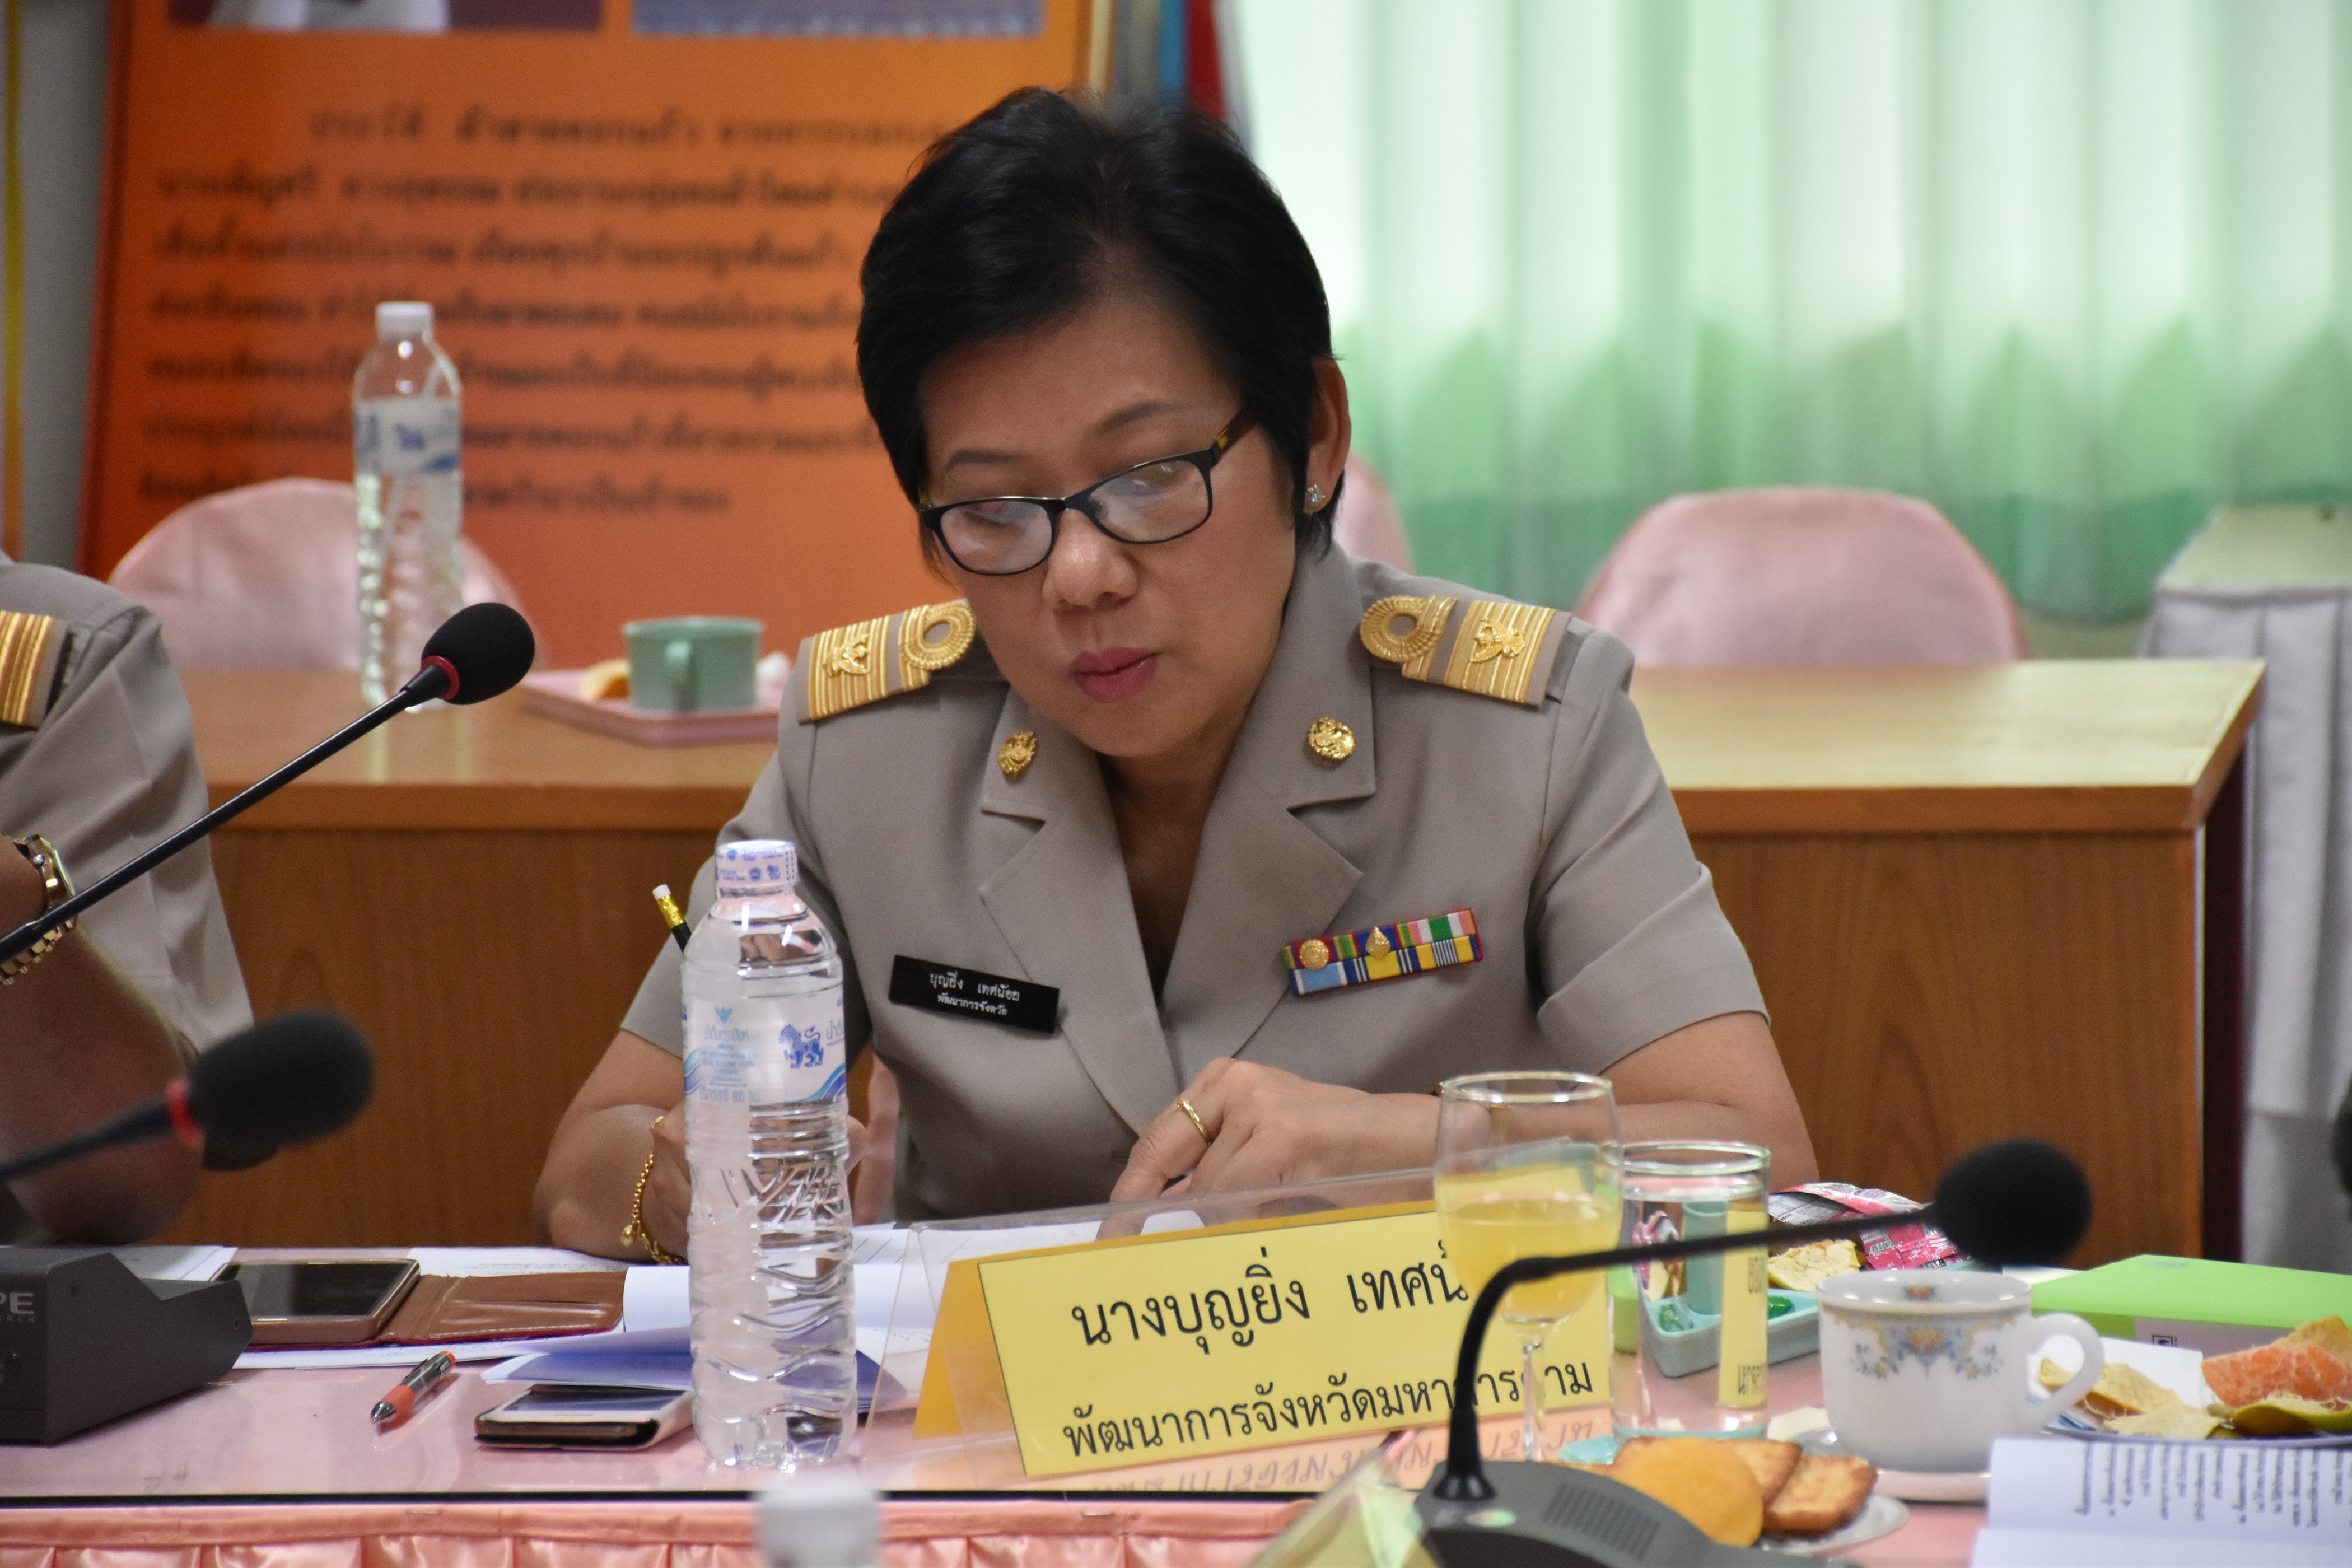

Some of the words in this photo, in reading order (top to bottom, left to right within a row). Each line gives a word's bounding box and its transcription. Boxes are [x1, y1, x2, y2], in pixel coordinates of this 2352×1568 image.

[1071, 1246, 1311, 1355] นางบุญยิ่ง
[1062, 1362, 1593, 1457] พัฒนาการจังหวัดมหาาราม
